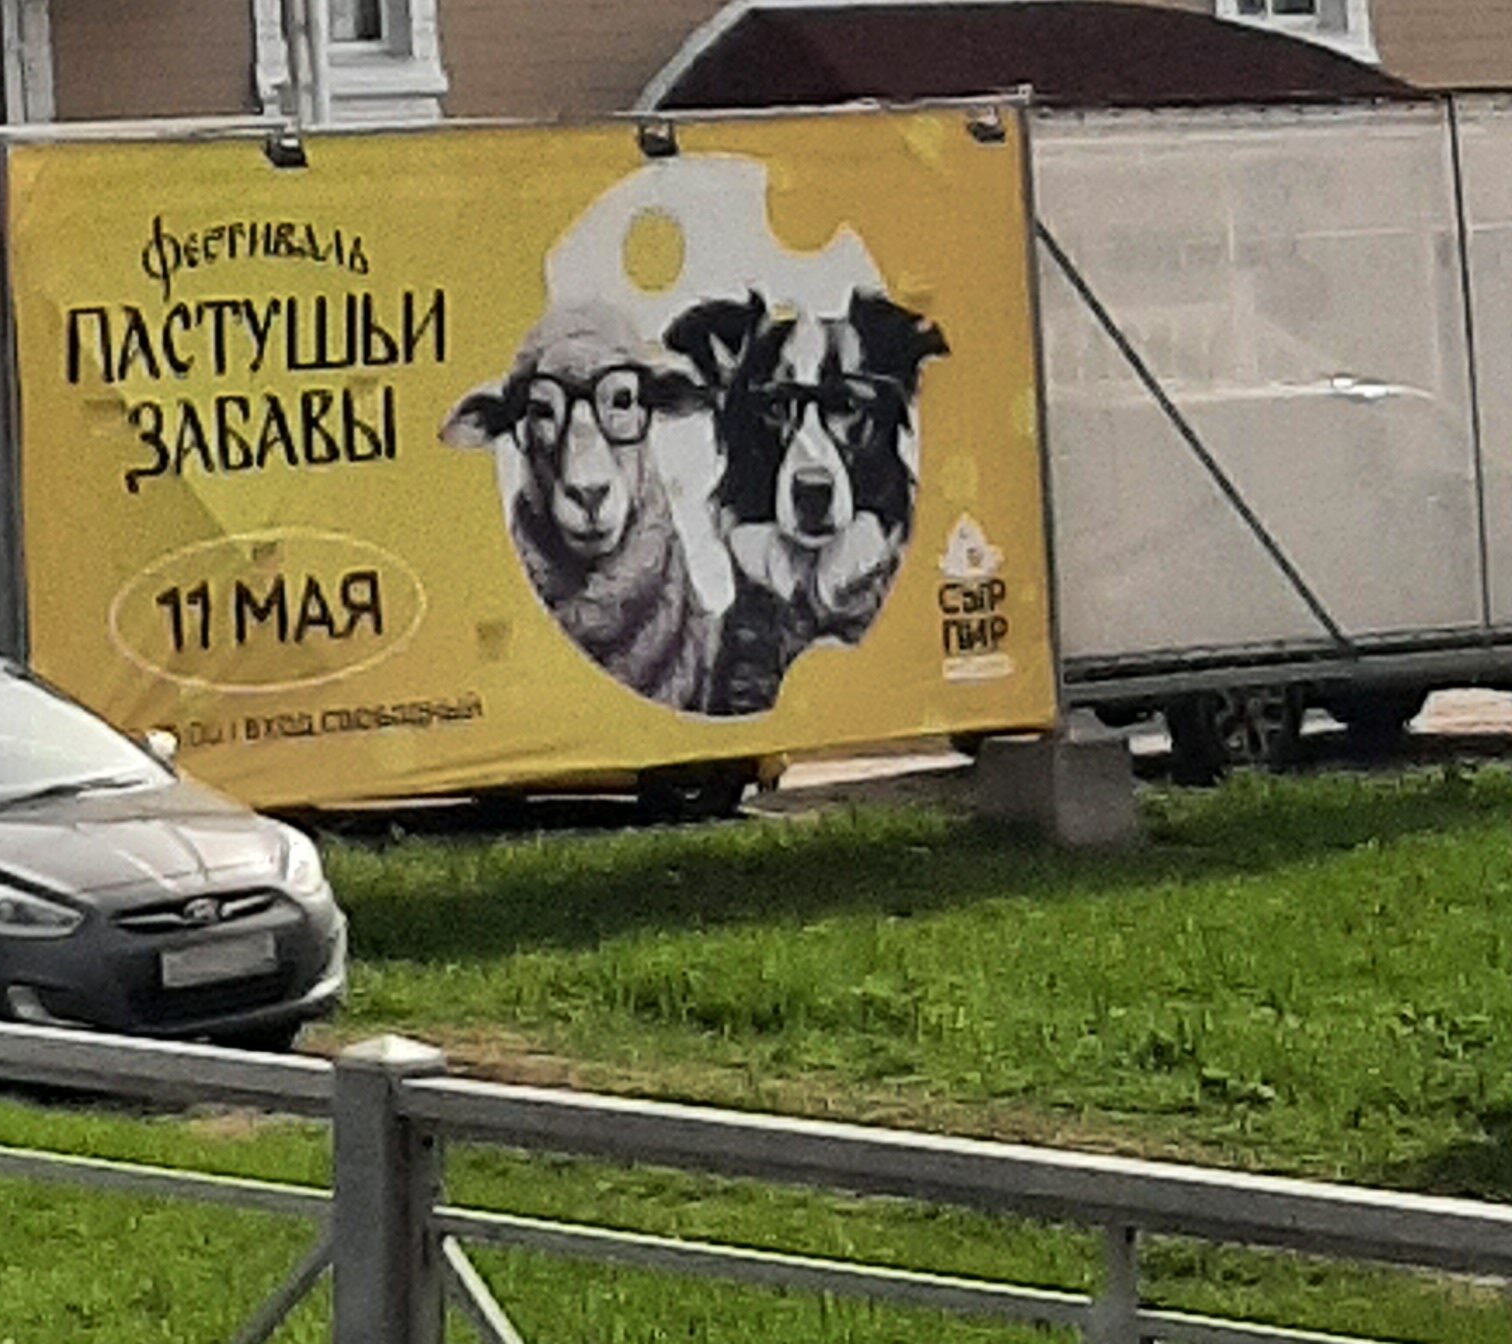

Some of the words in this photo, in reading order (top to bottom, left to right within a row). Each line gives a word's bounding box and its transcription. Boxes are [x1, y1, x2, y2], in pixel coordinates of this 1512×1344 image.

[66, 288, 446, 385] ПАСТУШЬИ
[124, 385, 397, 494] ЗАБАВЫ
[156, 585, 211, 653] 11
[234, 568, 384, 645] МАЯ
